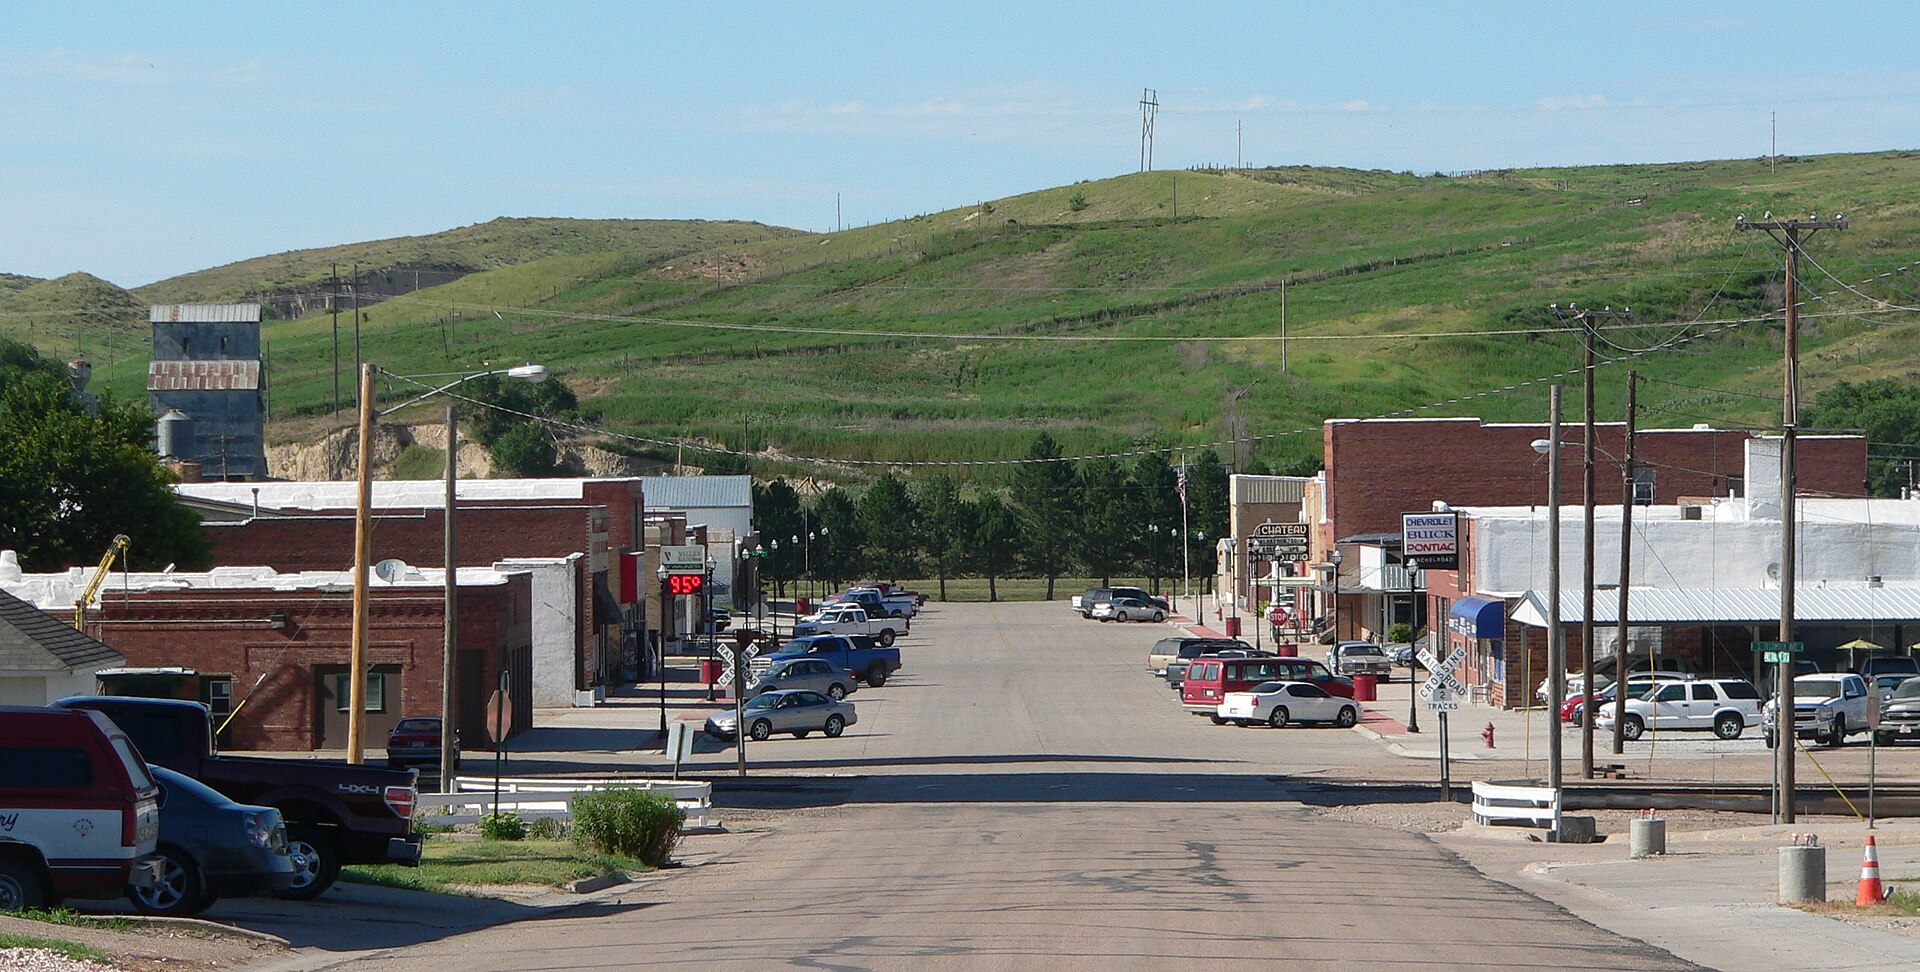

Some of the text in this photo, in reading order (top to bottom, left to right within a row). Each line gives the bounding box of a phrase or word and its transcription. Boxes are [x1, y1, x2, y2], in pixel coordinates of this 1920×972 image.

[1406, 518, 1453, 526] CHEVROLET
[1261, 526, 1308, 535] CHATEAU
[1407, 530, 1454, 539] BUICK
[1407, 543, 1454, 552] PONTIAC
[1270, 613, 1287, 621] STOP
[1420, 648, 1465, 698] CROSSING
[1439, 691, 1446, 699] 2
[1428, 703, 1458, 711] TRACKS
